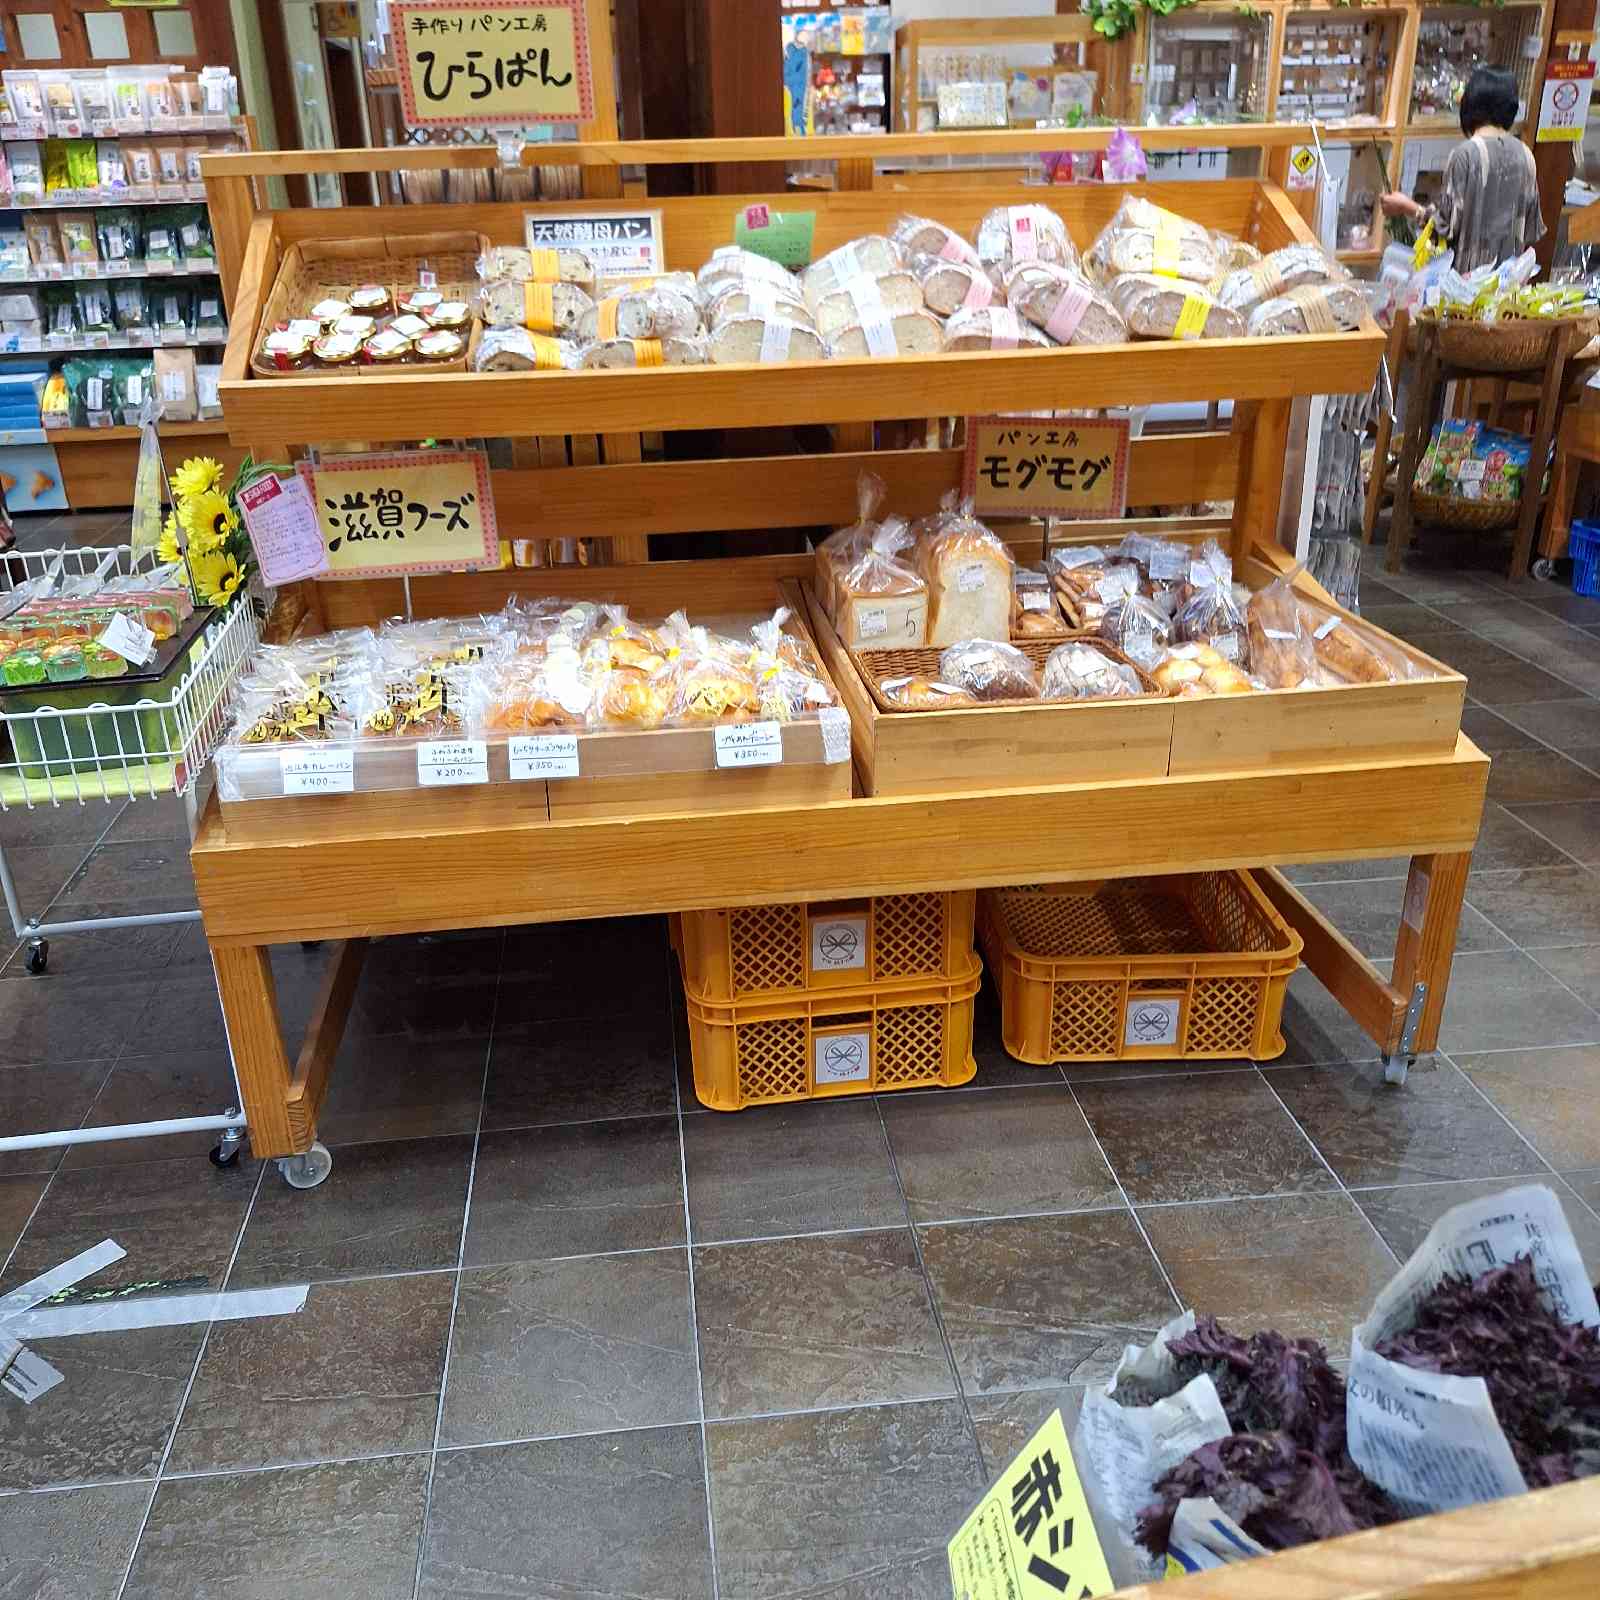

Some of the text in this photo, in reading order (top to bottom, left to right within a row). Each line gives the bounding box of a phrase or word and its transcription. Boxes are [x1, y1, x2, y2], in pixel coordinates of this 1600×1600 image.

[411, 14, 548, 36] 手作りパン工房
[416, 48, 572, 101] ひらぱん
[534, 220, 648, 240] 天然酵母パン
[997, 430, 1079, 447] パン工房
[980, 454, 1112, 491] モグモグ
[325, 487, 475, 552] 滋賀フーズ
[1011, 1448, 1093, 1600] 赤シ
